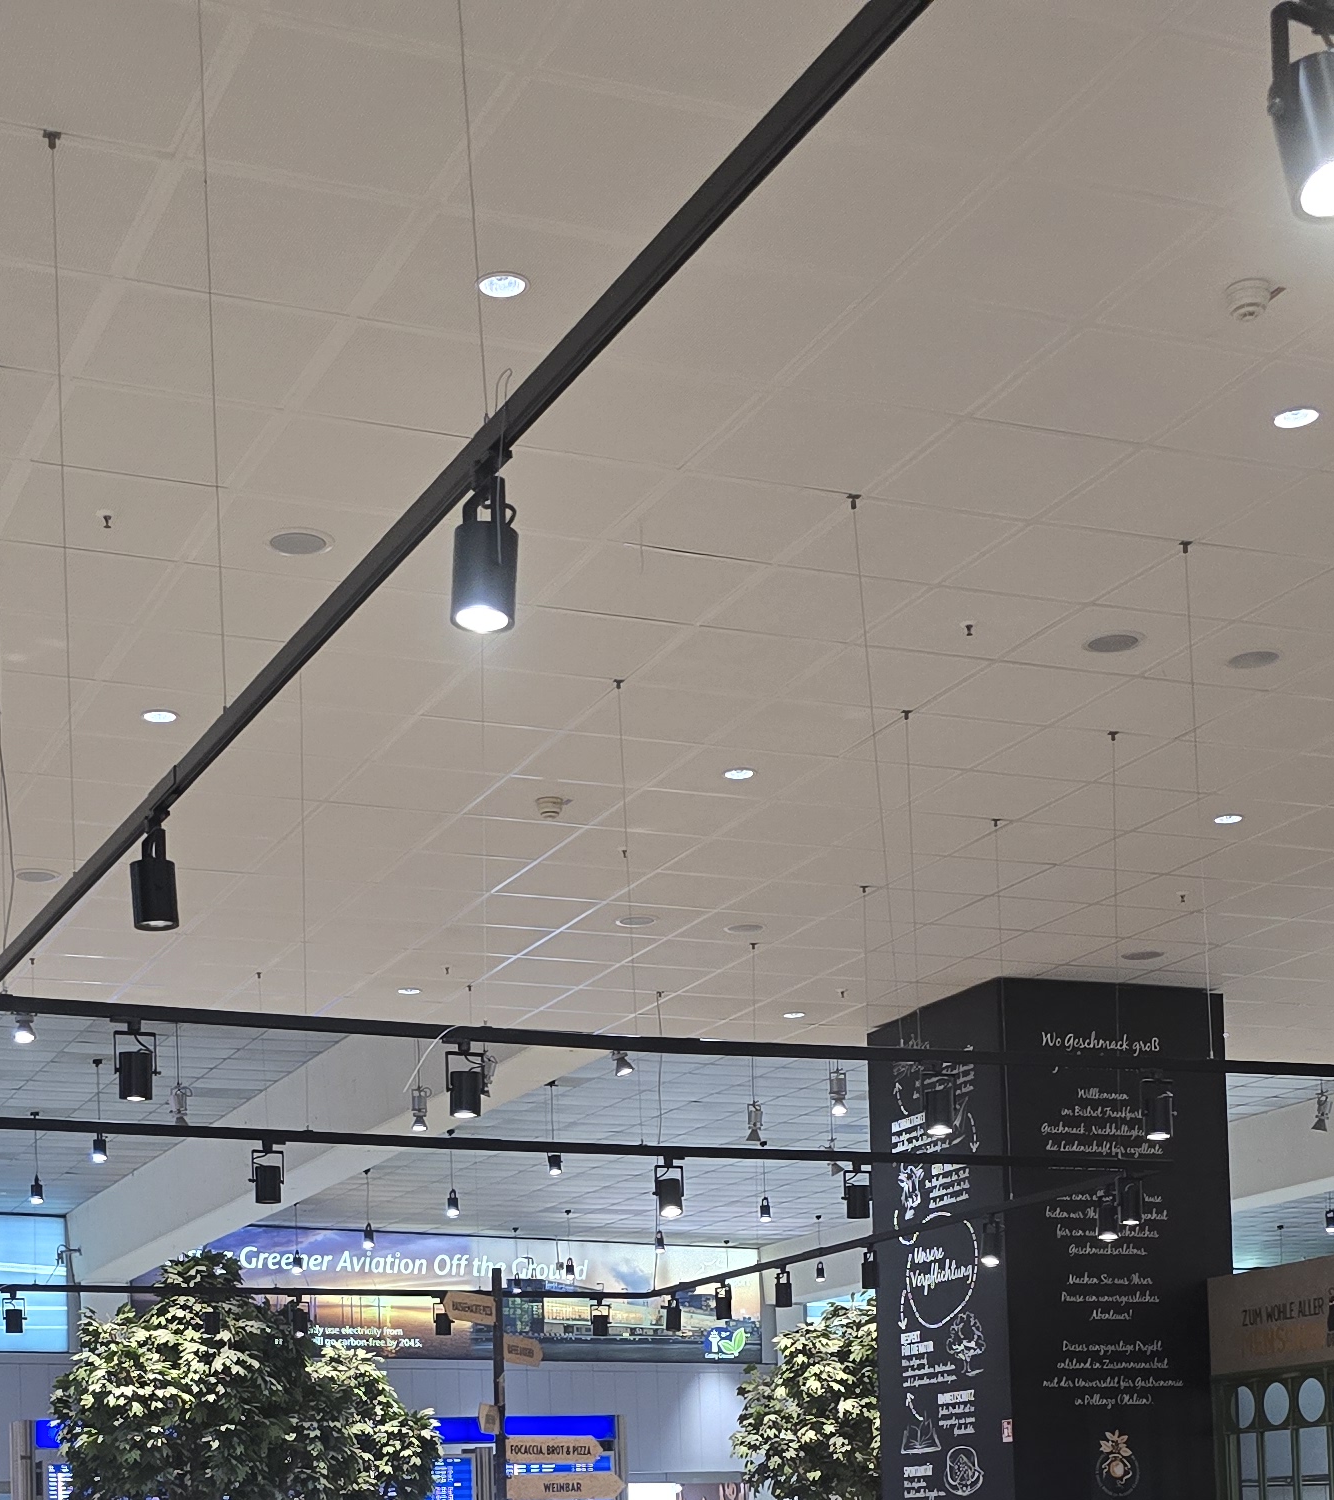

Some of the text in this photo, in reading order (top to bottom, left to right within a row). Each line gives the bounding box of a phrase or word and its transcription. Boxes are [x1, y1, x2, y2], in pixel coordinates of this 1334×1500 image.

[1041, 1031, 1160, 1056] Wo Geschmack groß
[1077, 1088, 1130, 1101] Willkommen
[336, 1249, 428, 1276] Aviation
[433, 1253, 470, 1277] Off
[913, 1246, 945, 1264] Unsere
[910, 1258, 973, 1296] Verpflichtung
[1242, 1308, 1263, 1327] ZUM
[1267, 1300, 1294, 1322] WOHLE
[1298, 1297, 1325, 1317] ALLER
[341, 1325, 382, 1338] electricity
[383, 1326, 404, 1336] from
[546, 1445, 565, 1456] BROT
[572, 1445, 593, 1456] PIZZA
[543, 1482, 583, 1493] WEINBAR
